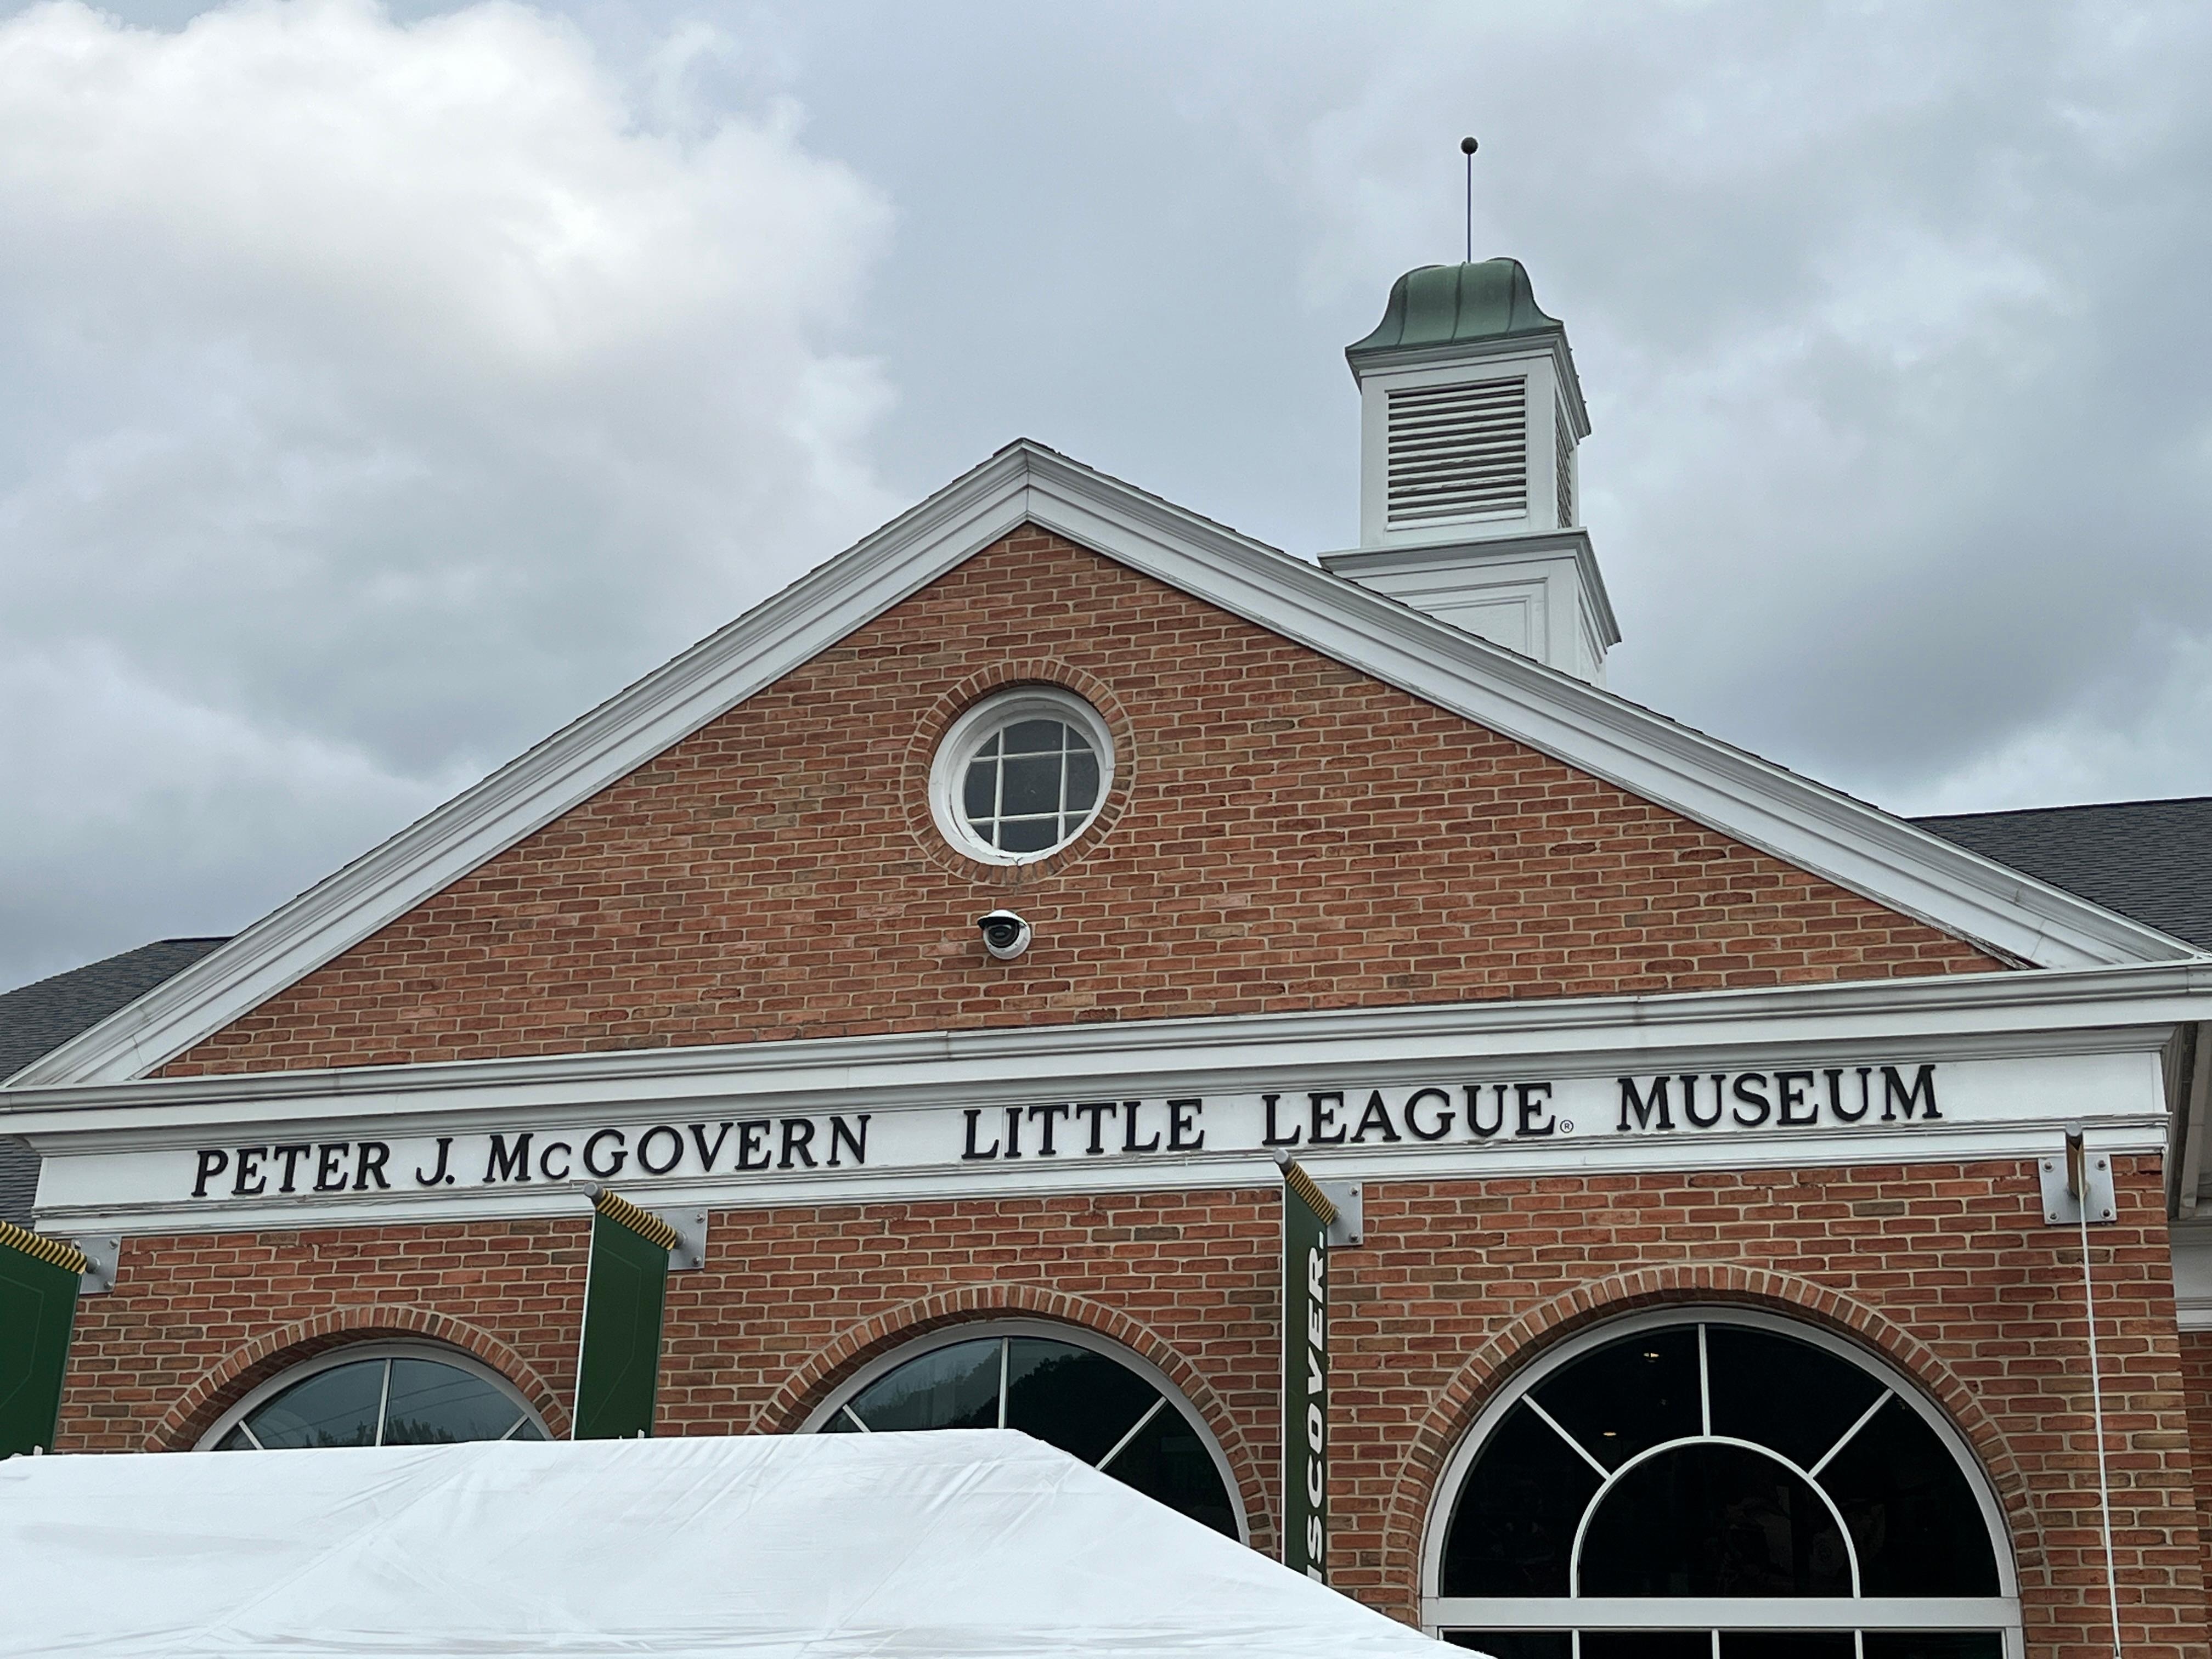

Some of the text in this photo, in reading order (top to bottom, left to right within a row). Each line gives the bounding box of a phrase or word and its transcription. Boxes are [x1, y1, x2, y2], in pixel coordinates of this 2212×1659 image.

[190, 1141, 391, 1198] PETER
[415, 1137, 456, 1187] J.
[961, 1097, 1205, 1160] LITTLE
[1615, 1064, 1943, 1131] MUSEUM
